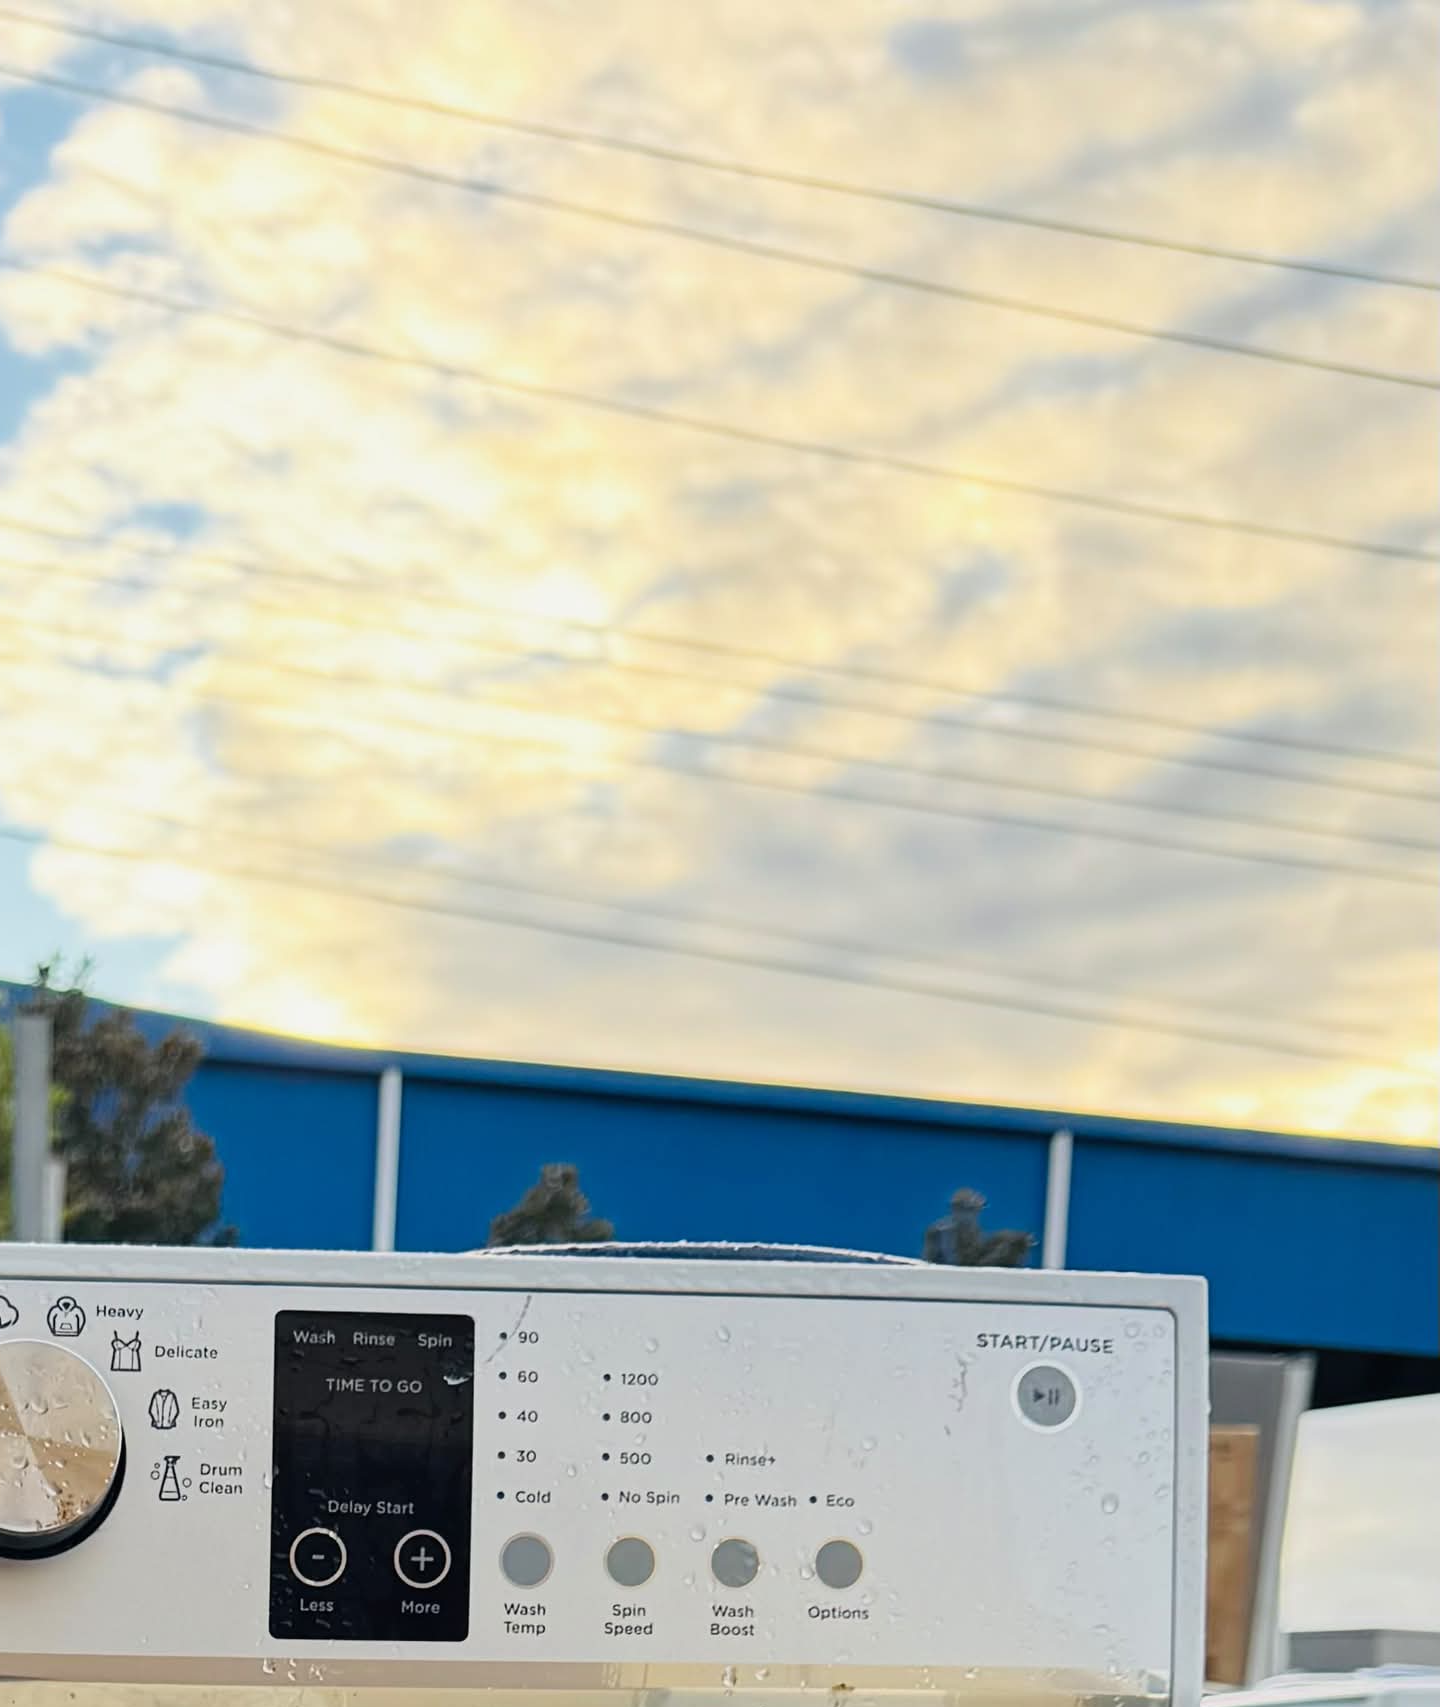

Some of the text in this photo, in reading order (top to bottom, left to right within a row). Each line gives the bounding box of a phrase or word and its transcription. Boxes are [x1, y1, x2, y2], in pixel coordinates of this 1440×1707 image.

[96, 1305, 144, 1321] Heavy
[292, 1330, 336, 1344] Wash
[353, 1332, 396, 1346] Rinse
[417, 1333, 453, 1349] Spin
[518, 1331, 539, 1344] 90
[976, 1333, 1114, 1354] START/PAUSE
[154, 1345, 218, 1360] Delicate
[517, 1370, 539, 1383] 60
[621, 1373, 659, 1386] 1200
[326, 1378, 423, 1394] TIME TO GO
[191, 1397, 227, 1414] Easy
[193, 1415, 224, 1428] Iron
[516, 1410, 539, 1423] 40
[620, 1411, 653, 1424] 800
[516, 1450, 537, 1463] 30
[620, 1452, 652, 1465] 500
[200, 1463, 243, 1476] Drum
[199, 1481, 243, 1495] Clean
[515, 1490, 551, 1504] Cold
[618, 1491, 680, 1507] No Spin
[724, 1493, 797, 1508] Pre Wash
[826, 1494, 855, 1508] Eco
[328, 1500, 414, 1516] Delay Start
[300, 1599, 334, 1613] Less
[401, 1601, 440, 1615] More
[504, 1602, 546, 1616] Wash
[612, 1604, 646, 1619] Spin
[712, 1605, 754, 1619] Wash
[808, 1606, 869, 1621] Options
[504, 1621, 546, 1636] Temp
[604, 1622, 653, 1637] Speed
[711, 1623, 755, 1637] Boost
